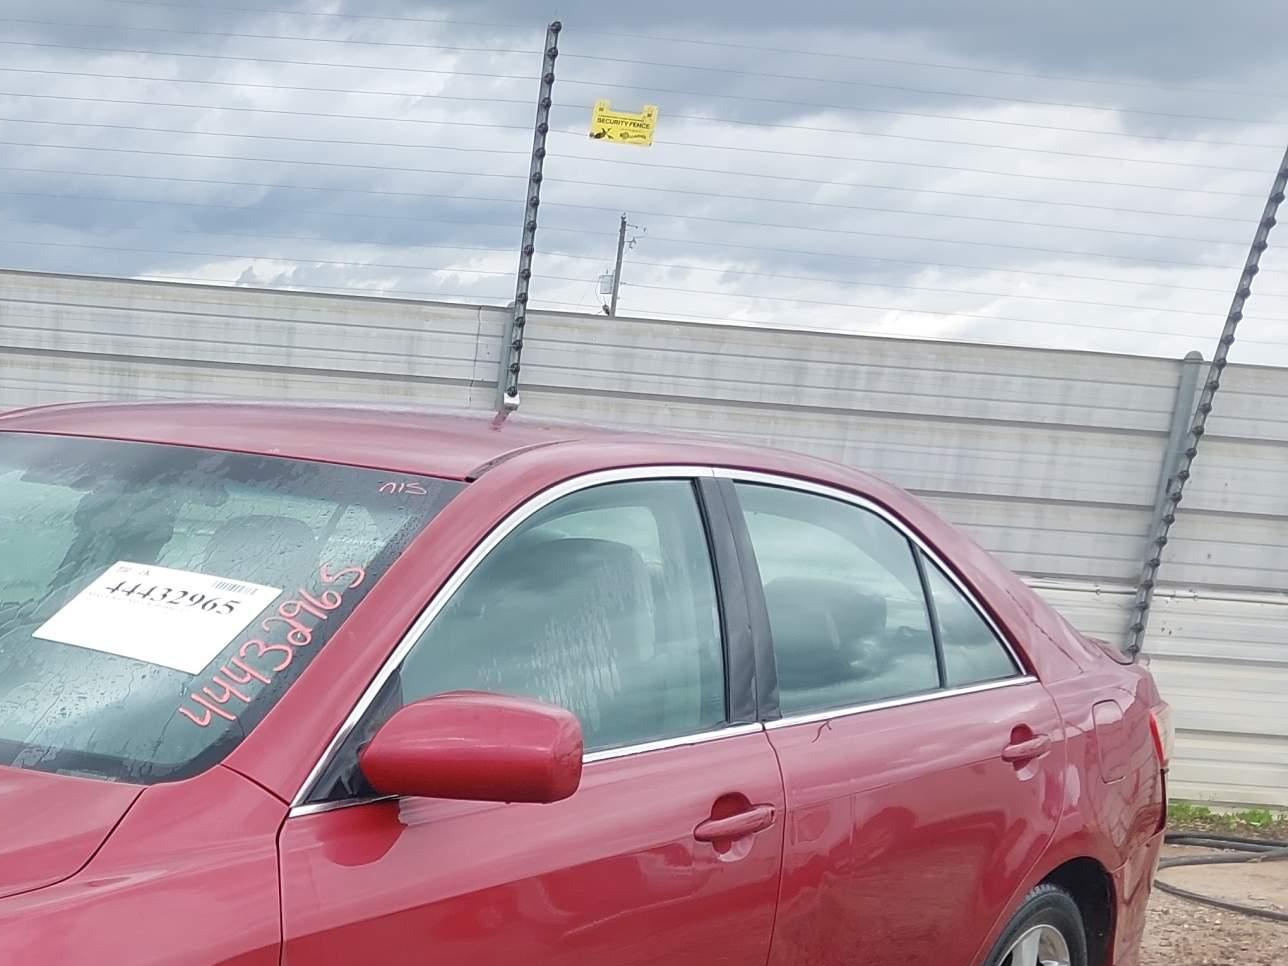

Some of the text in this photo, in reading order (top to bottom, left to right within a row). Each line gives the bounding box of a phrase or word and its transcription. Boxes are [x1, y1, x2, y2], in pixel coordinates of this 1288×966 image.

[597, 117, 650, 130] SECURITY FENCE
[105, 580, 241, 615] 44432965
[179, 564, 365, 727] 44432965
